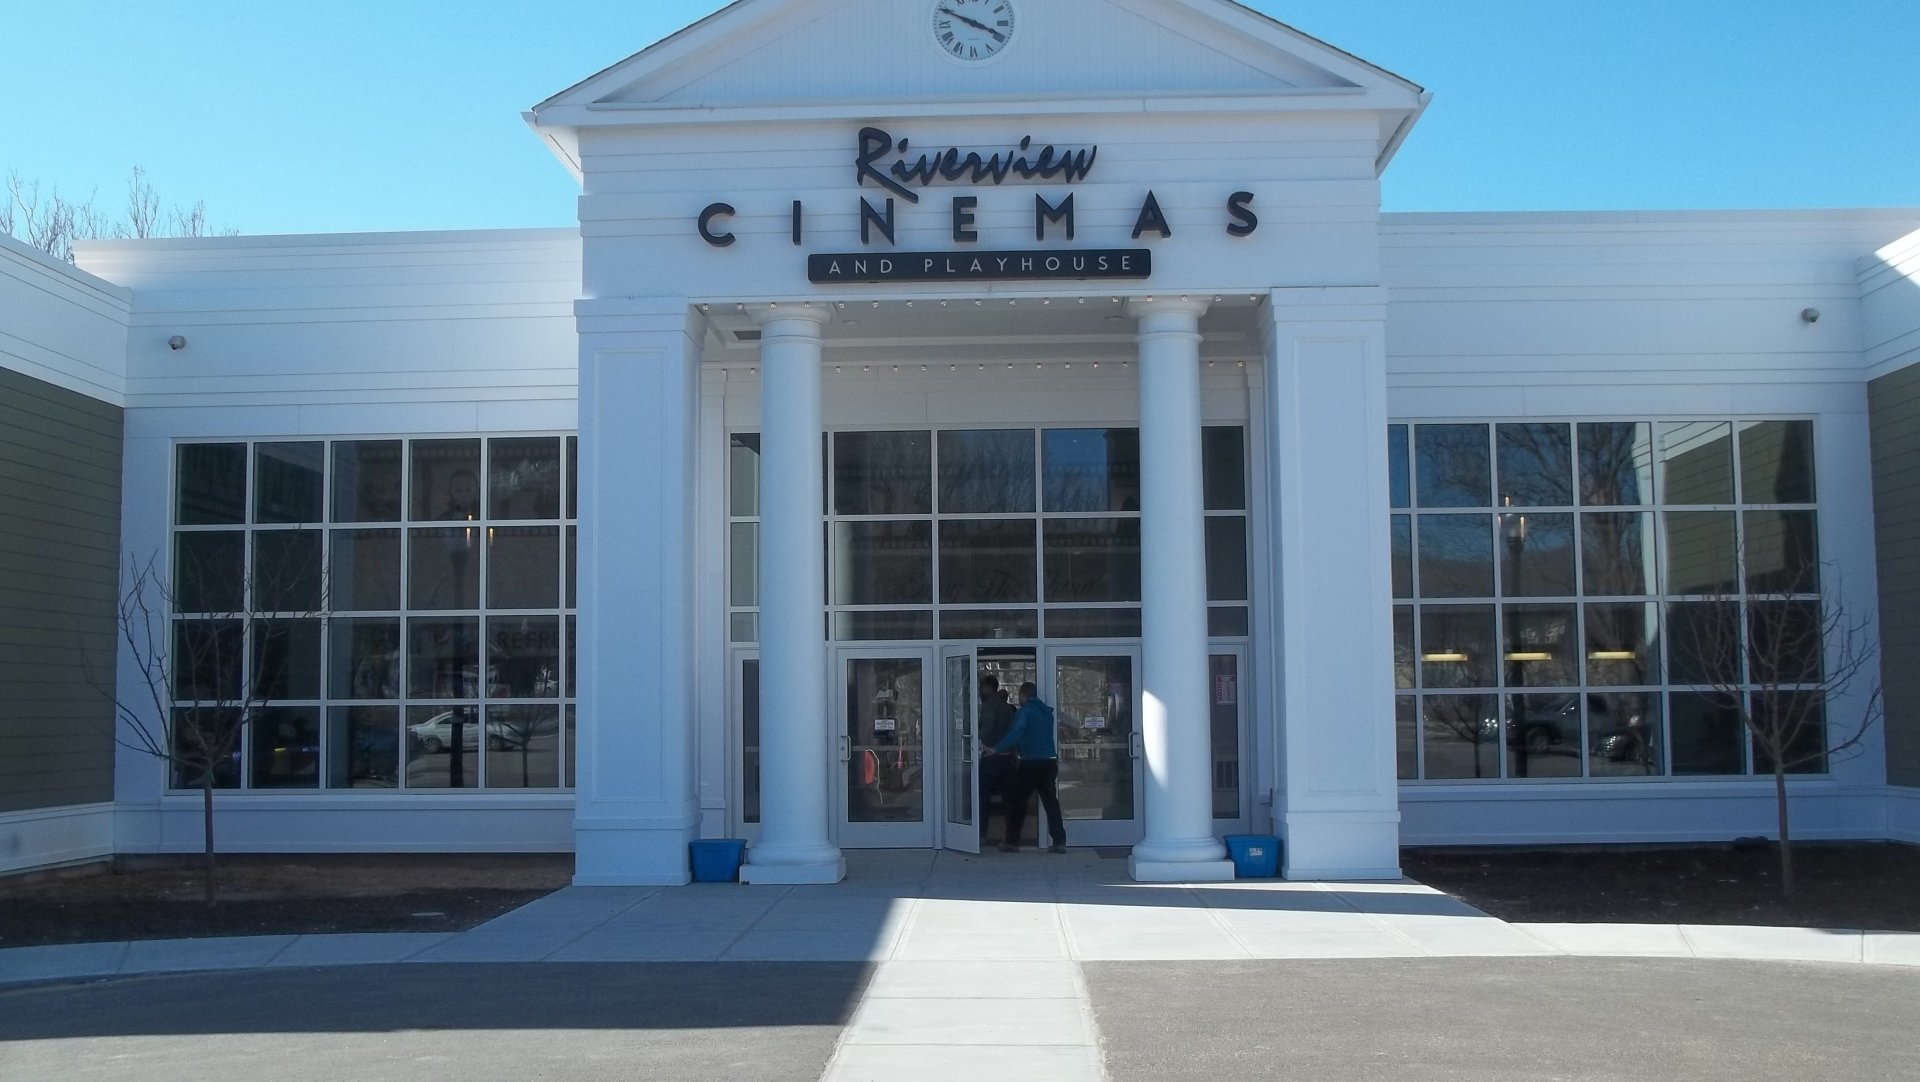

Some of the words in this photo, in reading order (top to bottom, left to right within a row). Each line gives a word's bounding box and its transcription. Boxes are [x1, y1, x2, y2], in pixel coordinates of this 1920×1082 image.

[856, 127, 1097, 204] Riverview
[698, 189, 1258, 247] CINEMAS
[829, 260, 893, 274] AND
[924, 255, 1131, 274] PLAYHOUSE
